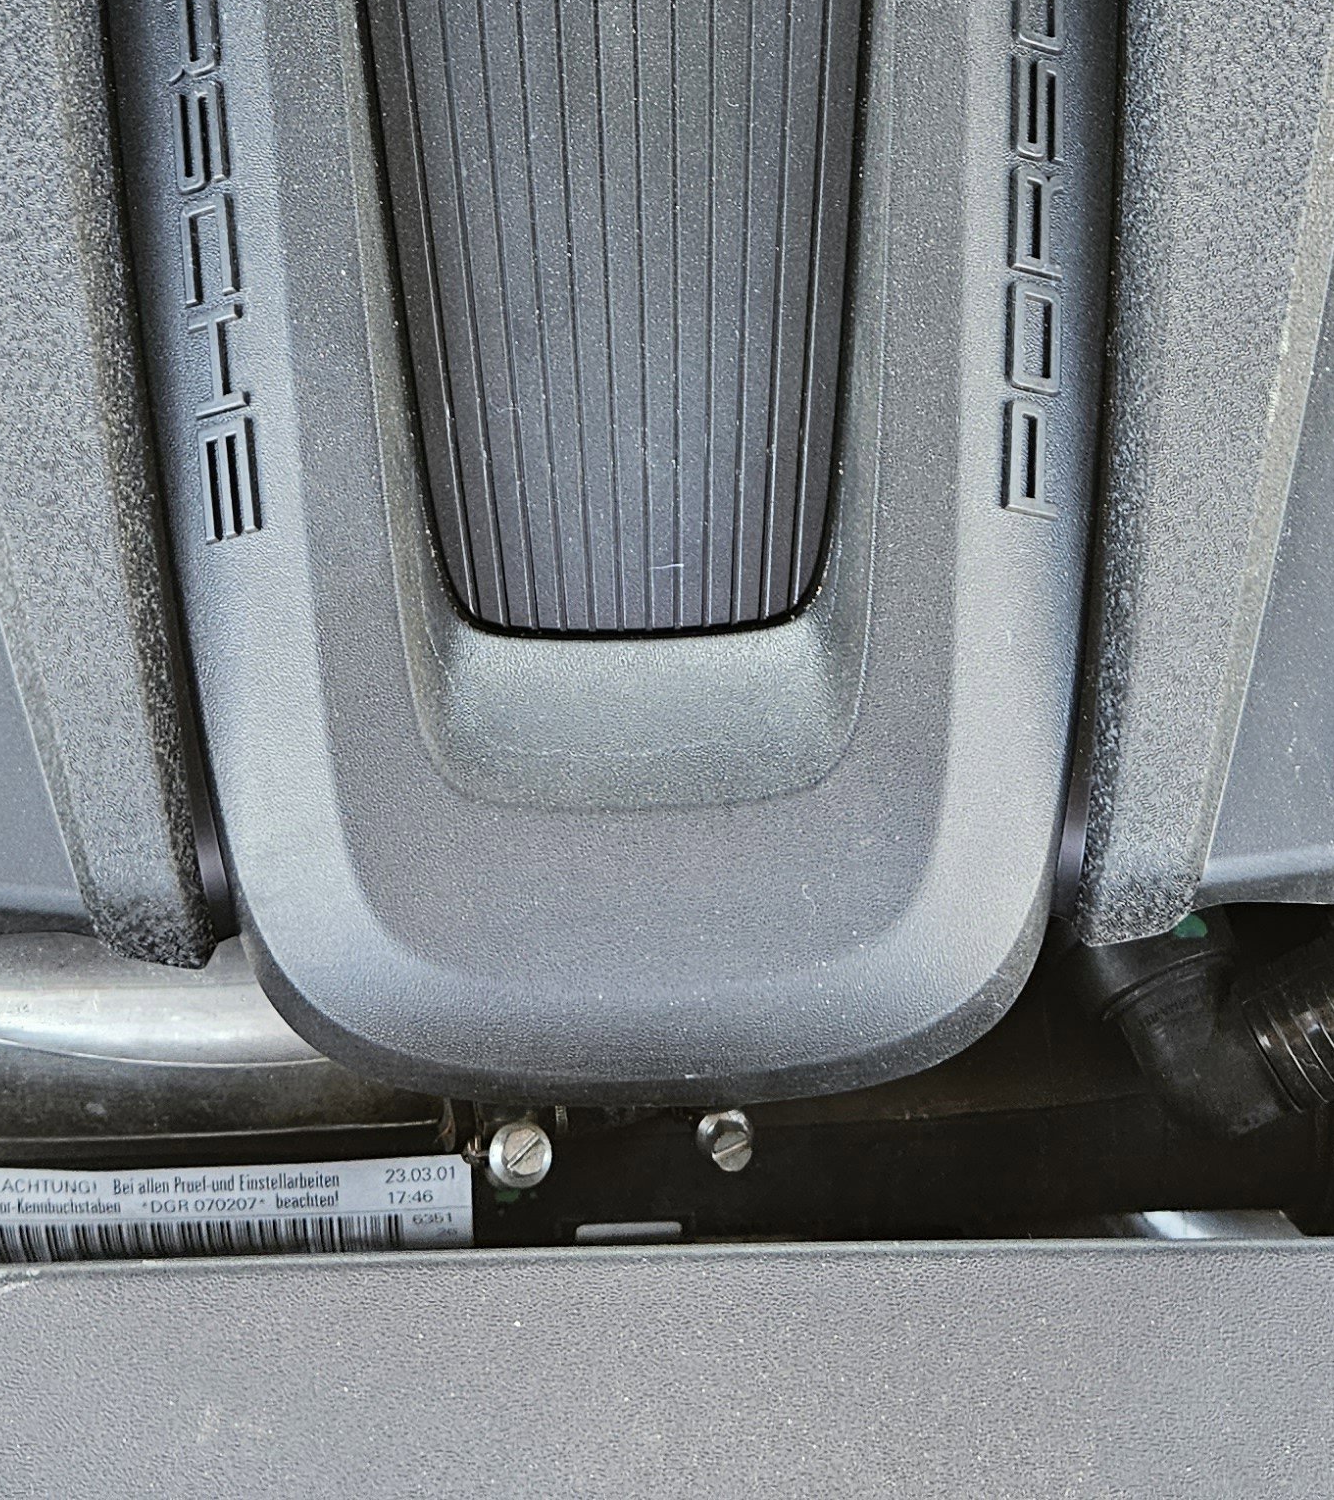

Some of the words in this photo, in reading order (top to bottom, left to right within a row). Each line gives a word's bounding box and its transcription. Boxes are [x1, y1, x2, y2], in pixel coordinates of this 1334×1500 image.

[1, 1177, 97, 1195] ACHTUNG!
[113, 1176, 135, 1195] Bei
[138, 1175, 170, 1195] allen
[239, 1171, 340, 1192] Einstellarbeiten
[385, 1165, 456, 1184] 23.03.01
[275, 1190, 340, 1210] beachten!
[388, 1190, 434, 1205] 17:46
